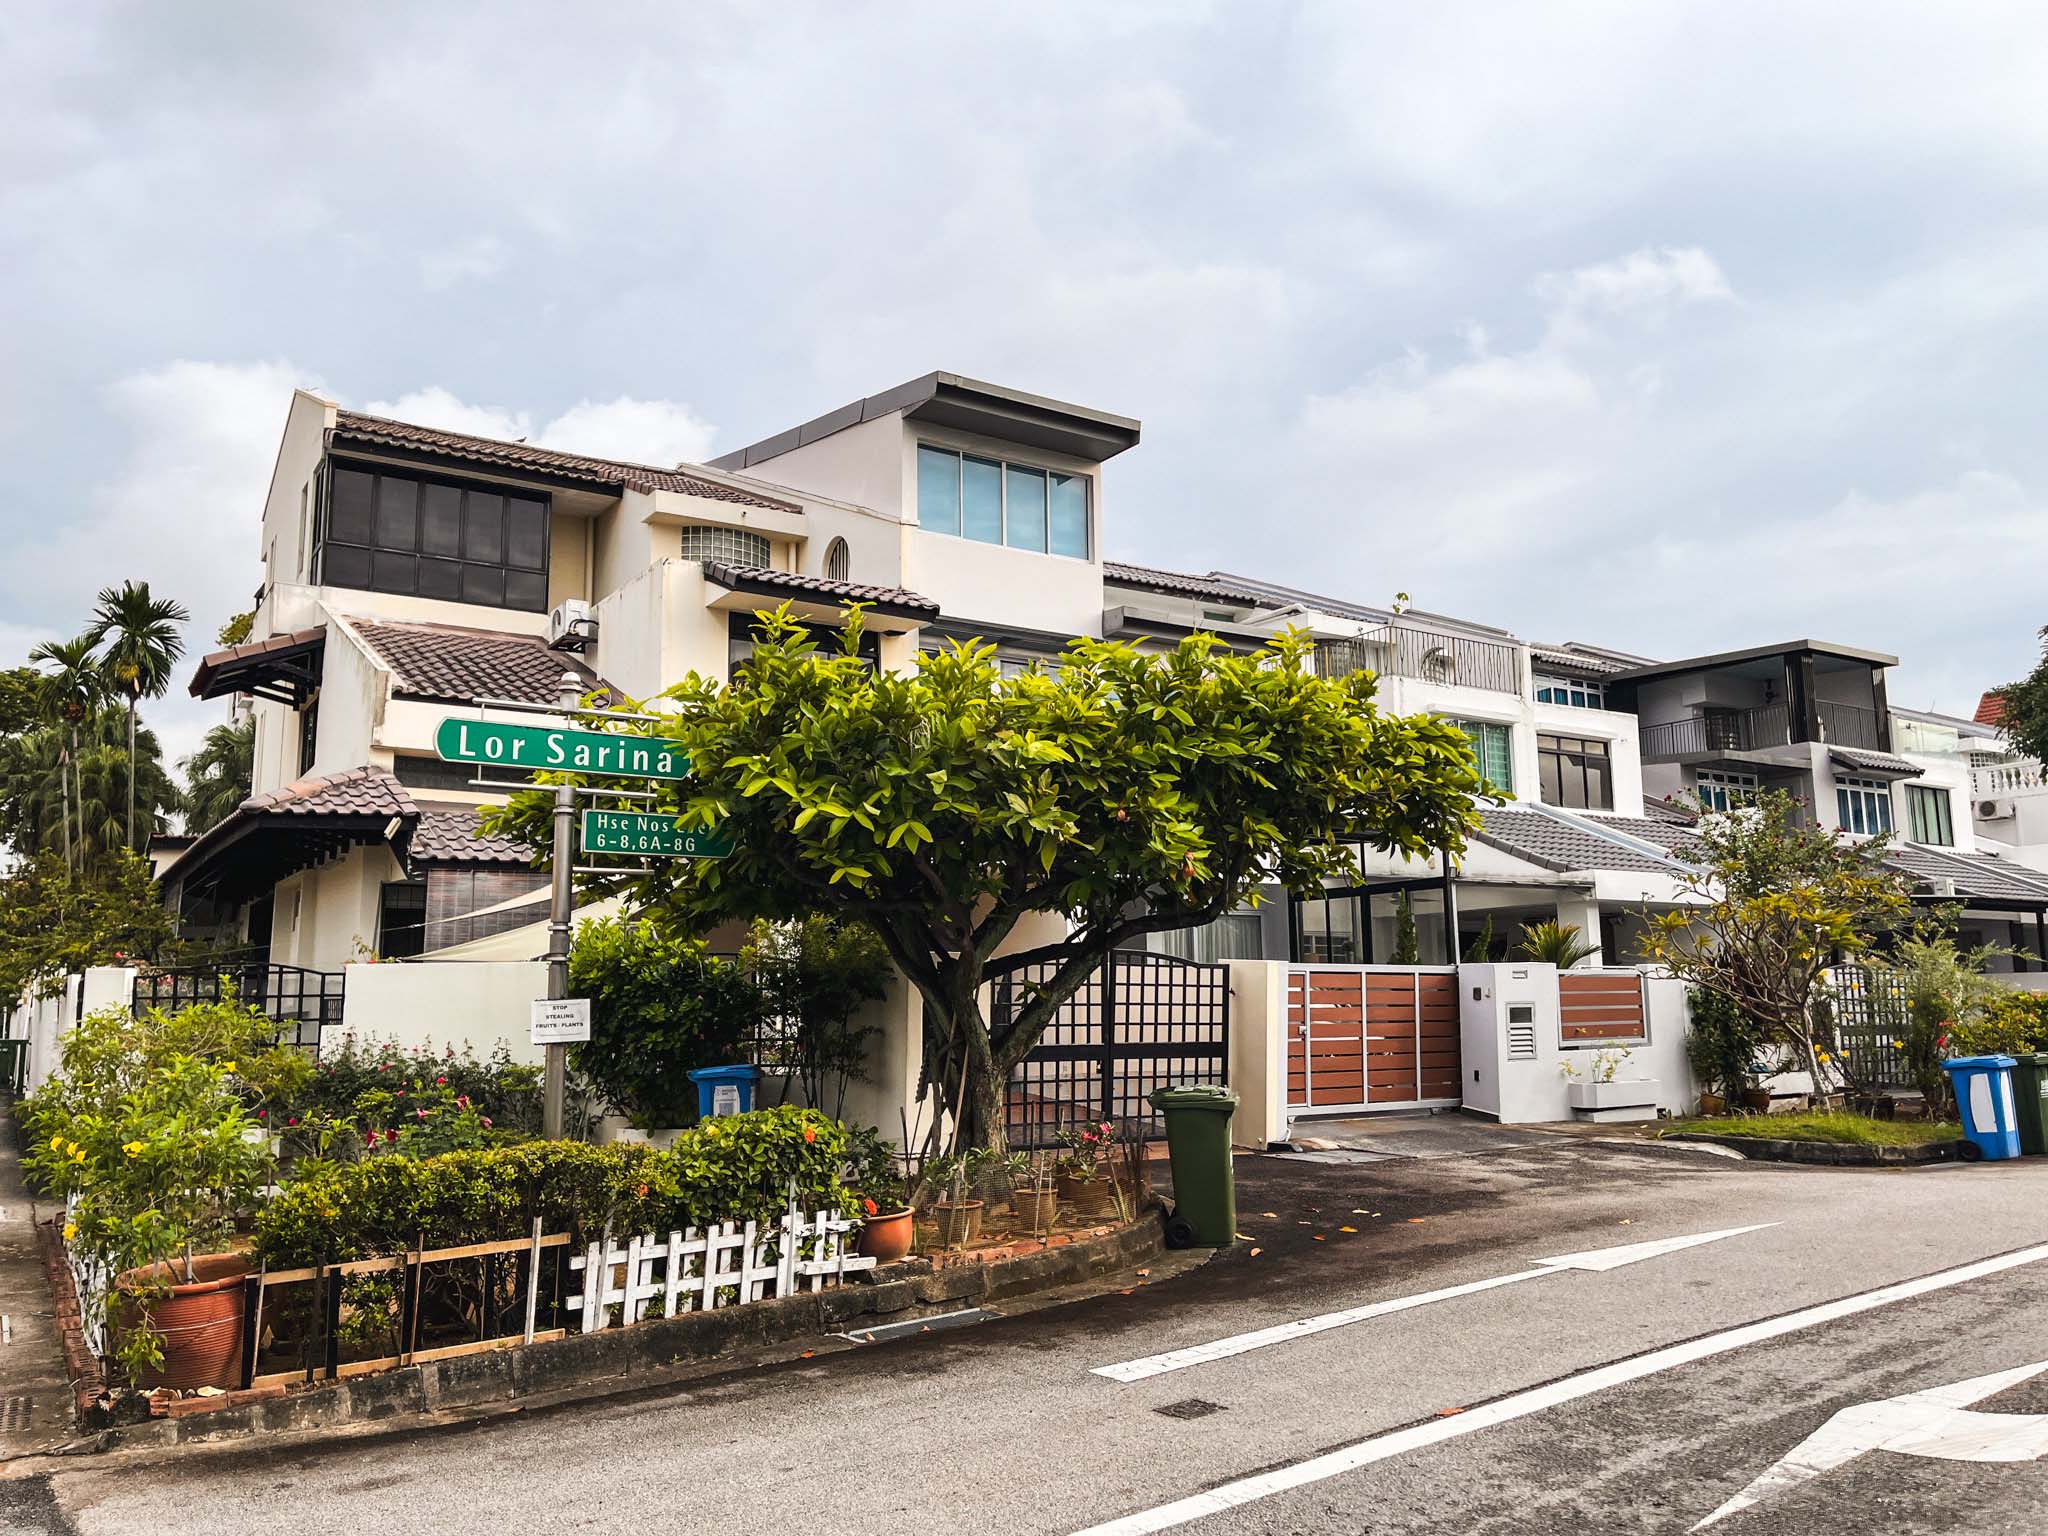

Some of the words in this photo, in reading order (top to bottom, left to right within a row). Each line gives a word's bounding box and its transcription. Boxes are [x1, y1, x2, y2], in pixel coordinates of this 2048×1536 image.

[459, 725, 525, 760] Lor
[546, 733, 672, 773] Sarina
[597, 814, 628, 830] Hse
[637, 816, 669, 832] Nos
